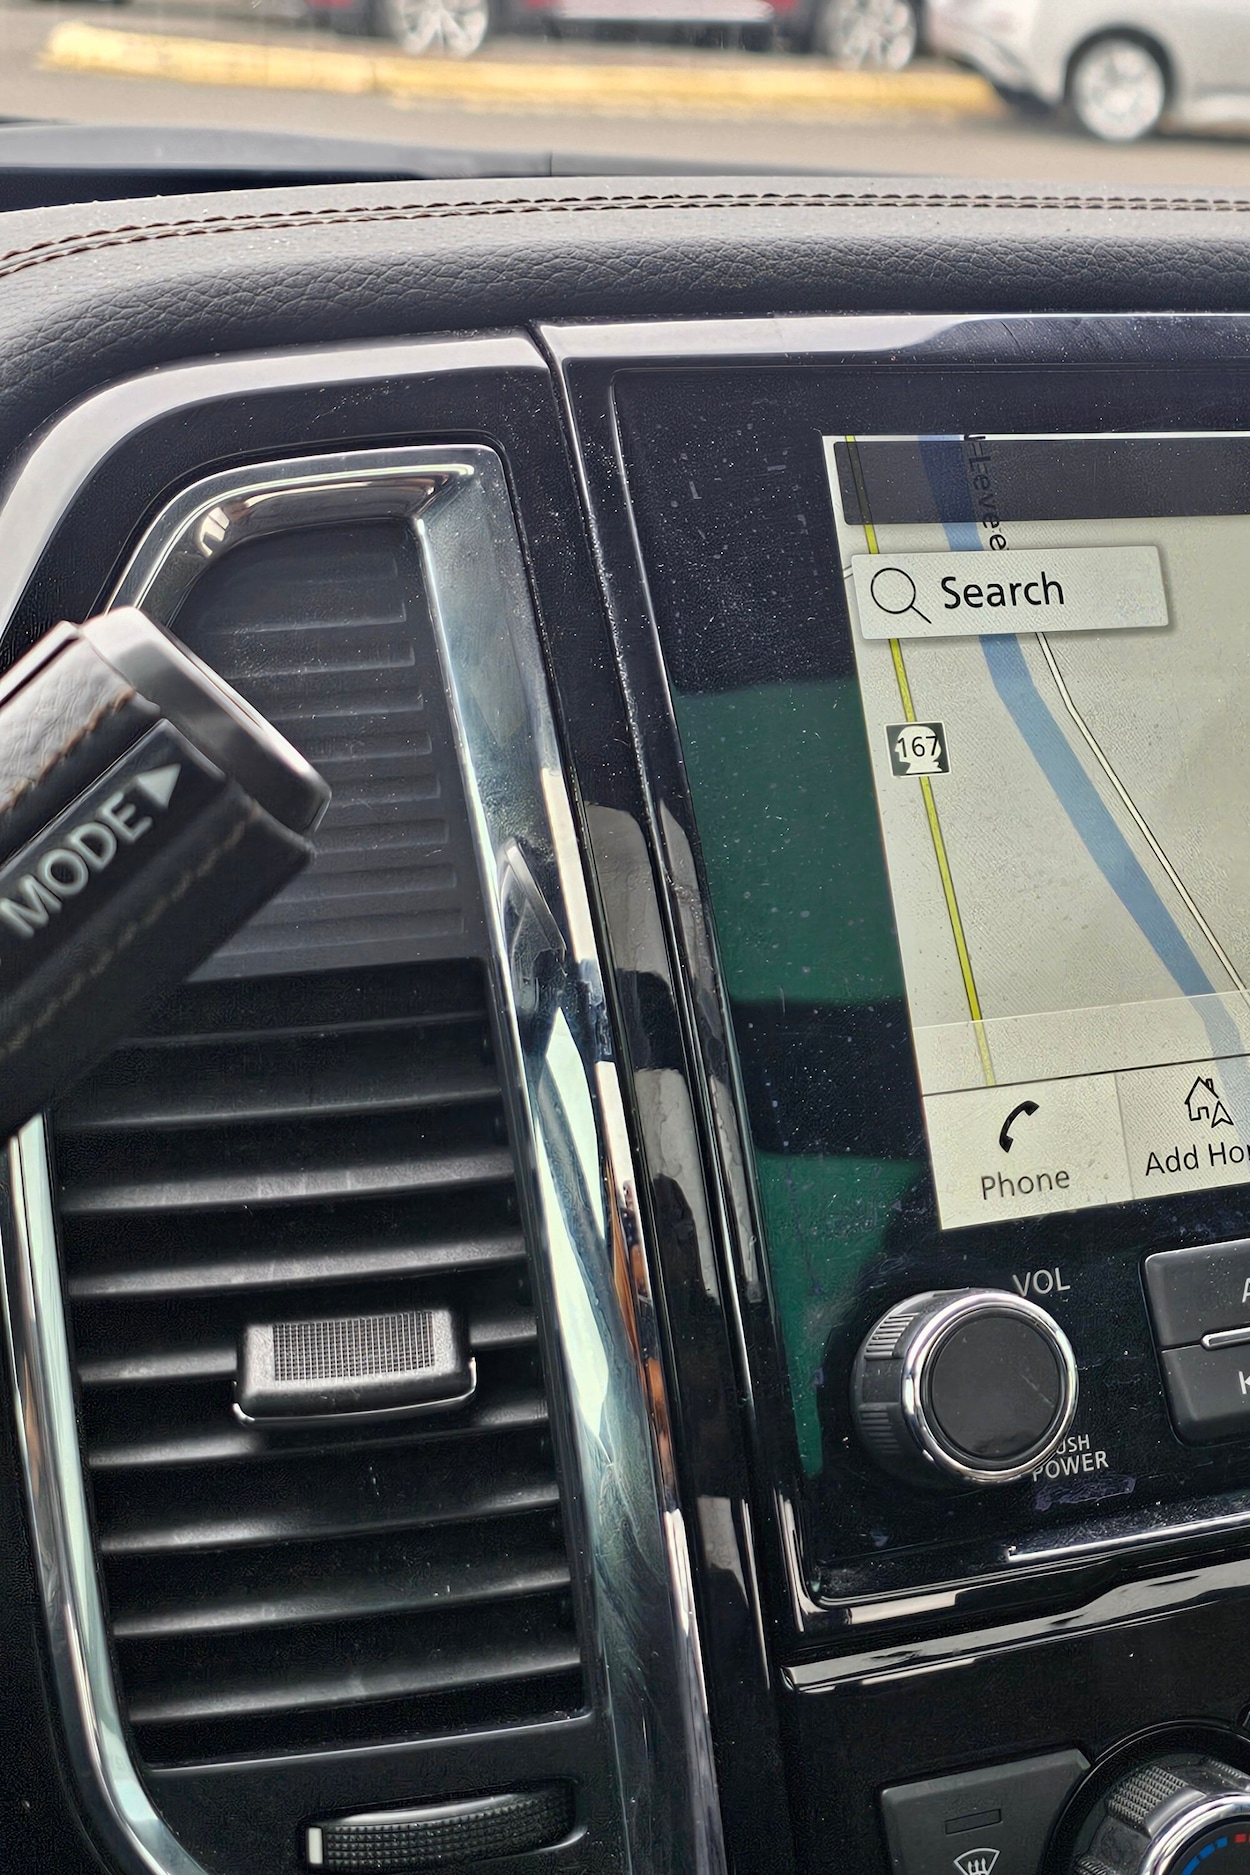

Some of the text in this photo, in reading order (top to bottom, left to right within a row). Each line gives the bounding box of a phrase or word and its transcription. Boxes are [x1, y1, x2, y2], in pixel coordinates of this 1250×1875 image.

[940, 571, 1065, 610] Search
[896, 735, 941, 760] 167
[0, 790, 154, 939] MODE
[1144, 1150, 1200, 1177] Add
[981, 1167, 1071, 1200] Phone
[1012, 1267, 1071, 1298] VOL
[1056, 1434, 1090, 1455] USH
[1032, 1450, 1109, 1482] POWER
